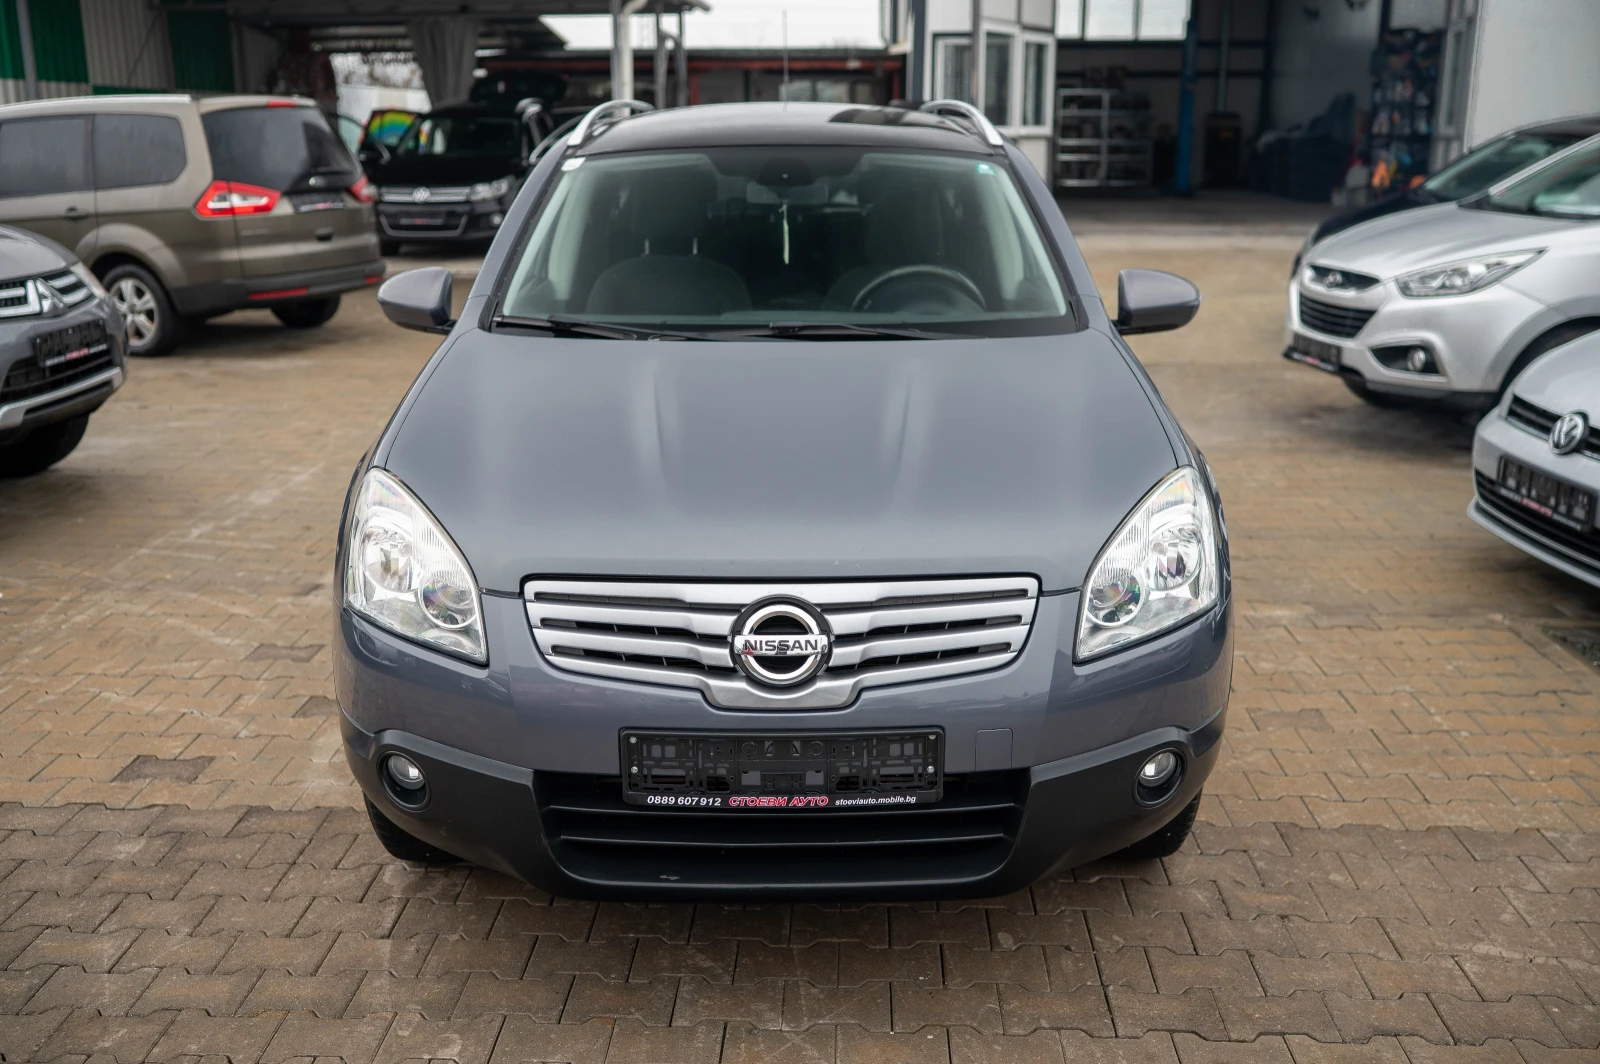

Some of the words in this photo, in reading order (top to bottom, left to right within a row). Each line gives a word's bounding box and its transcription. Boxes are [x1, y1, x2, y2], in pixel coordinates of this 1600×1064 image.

[743, 640, 818, 652] NISSAN
[647, 795, 675, 805] 0889
[677, 796, 698, 806] 607
[700, 797, 721, 806] 912
[729, 796, 787, 807] СТОЕВИ
[789, 796, 829, 807] АУТО
[835, 795, 916, 806] stoeviauto.mobile.bg
